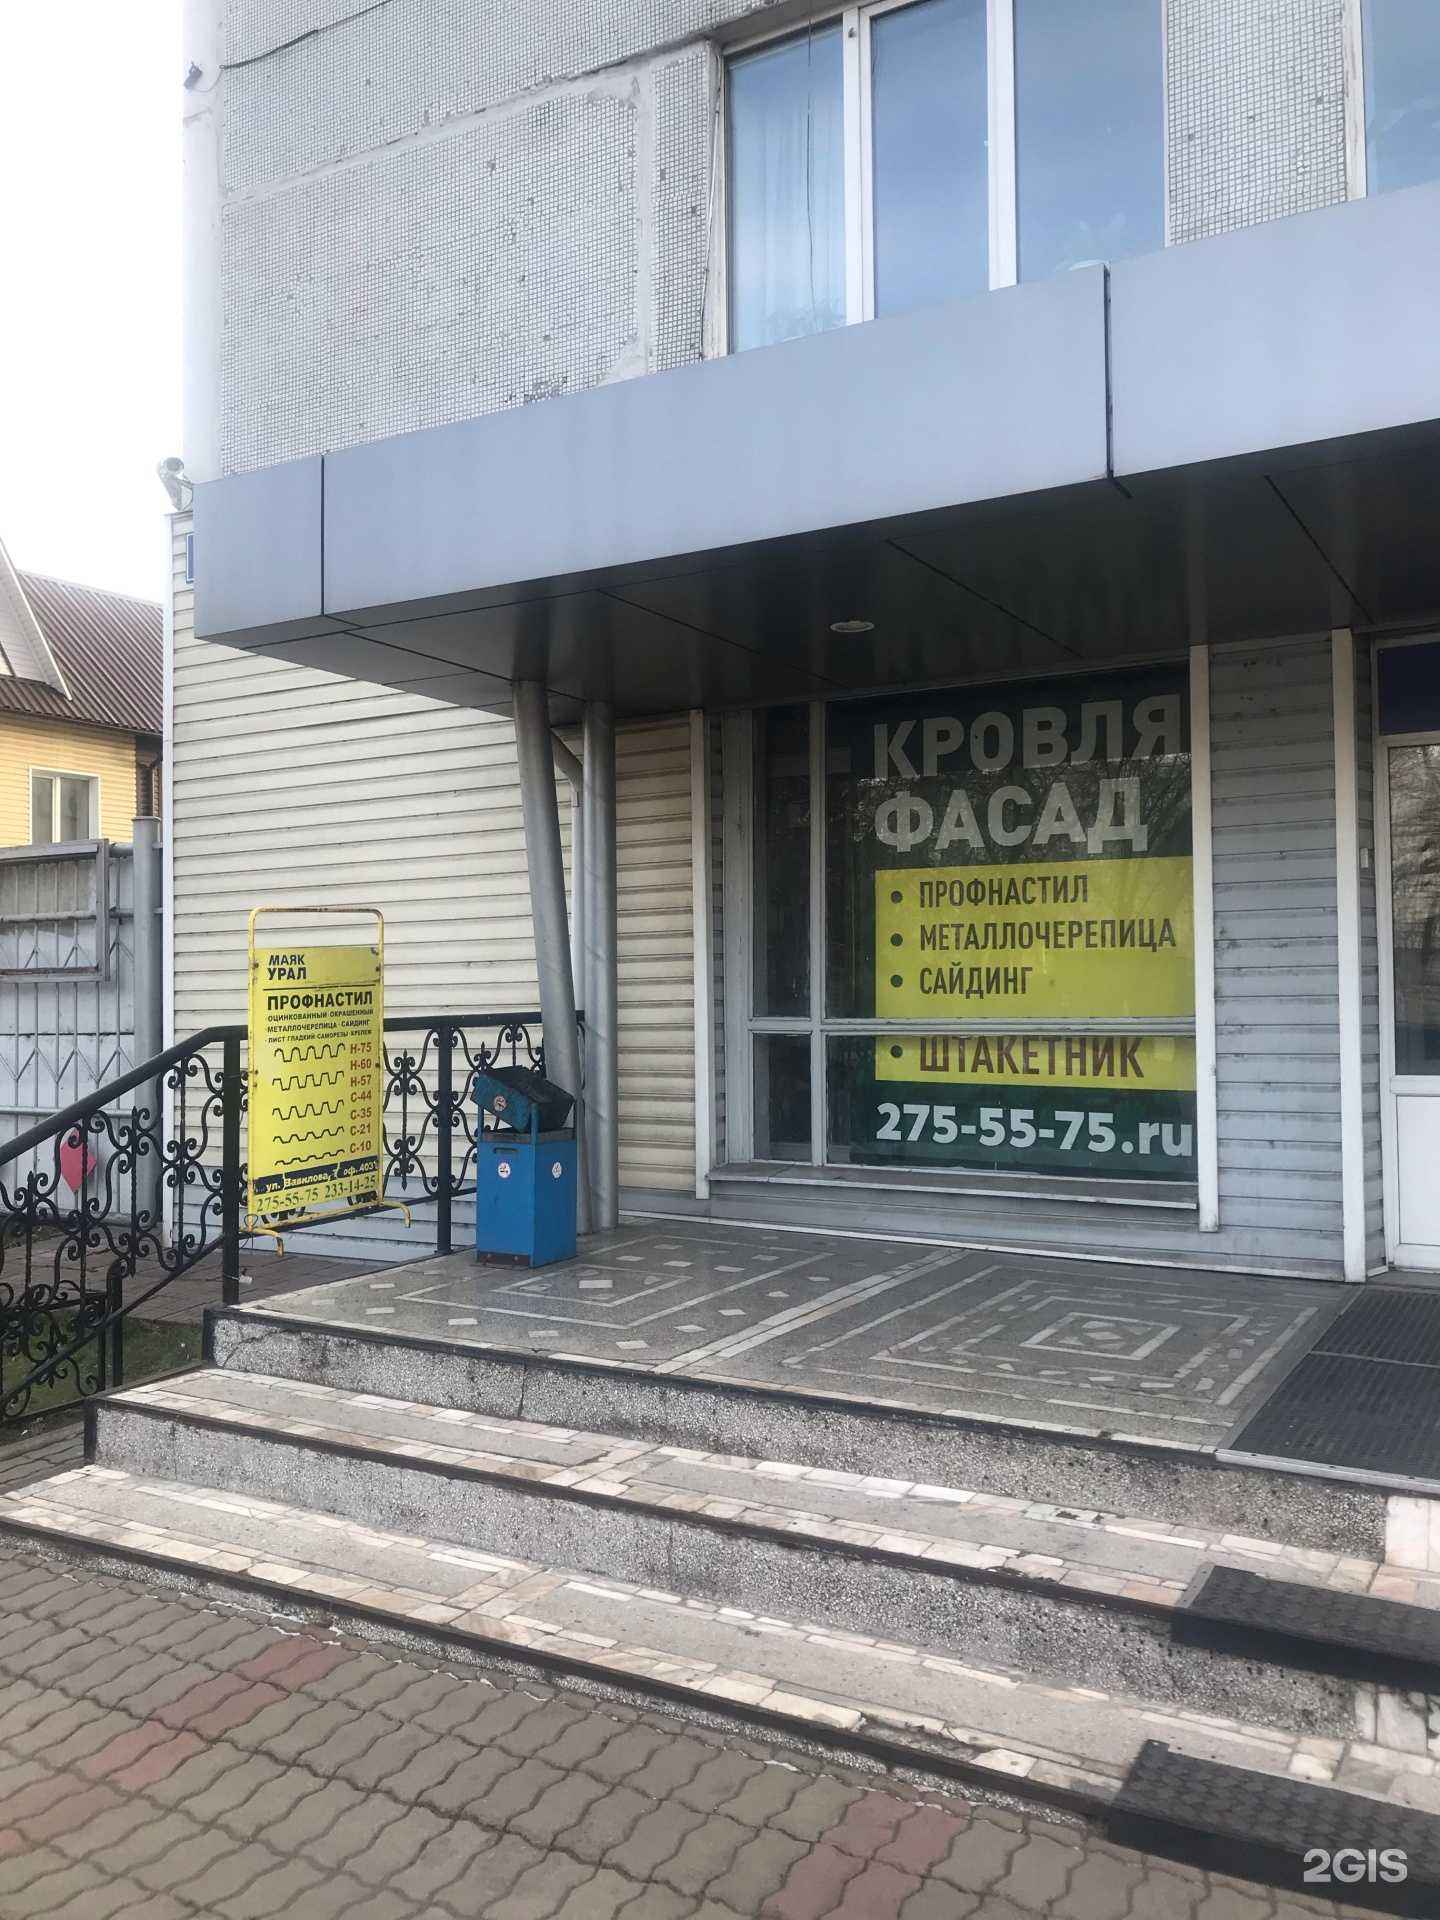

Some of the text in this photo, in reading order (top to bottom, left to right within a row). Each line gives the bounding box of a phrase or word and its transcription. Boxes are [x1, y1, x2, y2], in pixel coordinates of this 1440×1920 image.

[873, 694, 1181, 778] КРОВЛЯ
[874, 776, 1148, 854] ФАСАД
[919, 874, 1089, 908] ПРОФНАСТИЛ
[919, 918, 1177, 952] МЕТАЛЛОЧЕРЕПИЦА
[268, 954, 305, 966] МАЯК
[267, 966, 307, 980] УРАЛ
[919, 961, 1033, 1000] САЙДИНГ
[267, 990, 373, 1011] ПРОФНАСТИЛ
[267, 1022, 337, 1033] МЕТАЛЛОЧЕРЕПИЦА
[350, 1042, 372, 1054] Н-75
[919, 1036, 1145, 1078] ШТАКЕТНИК
[350, 1059, 372, 1071] Н-60
[350, 1090, 372, 1103] С-44
[350, 1107, 372, 1120] С-35
[350, 1123, 372, 1136] С-21
[875, 1102, 1193, 1157] 275-55-75.ru
[350, 1140, 372, 1153] С-10
[265, 1182, 281, 1193] ул.
